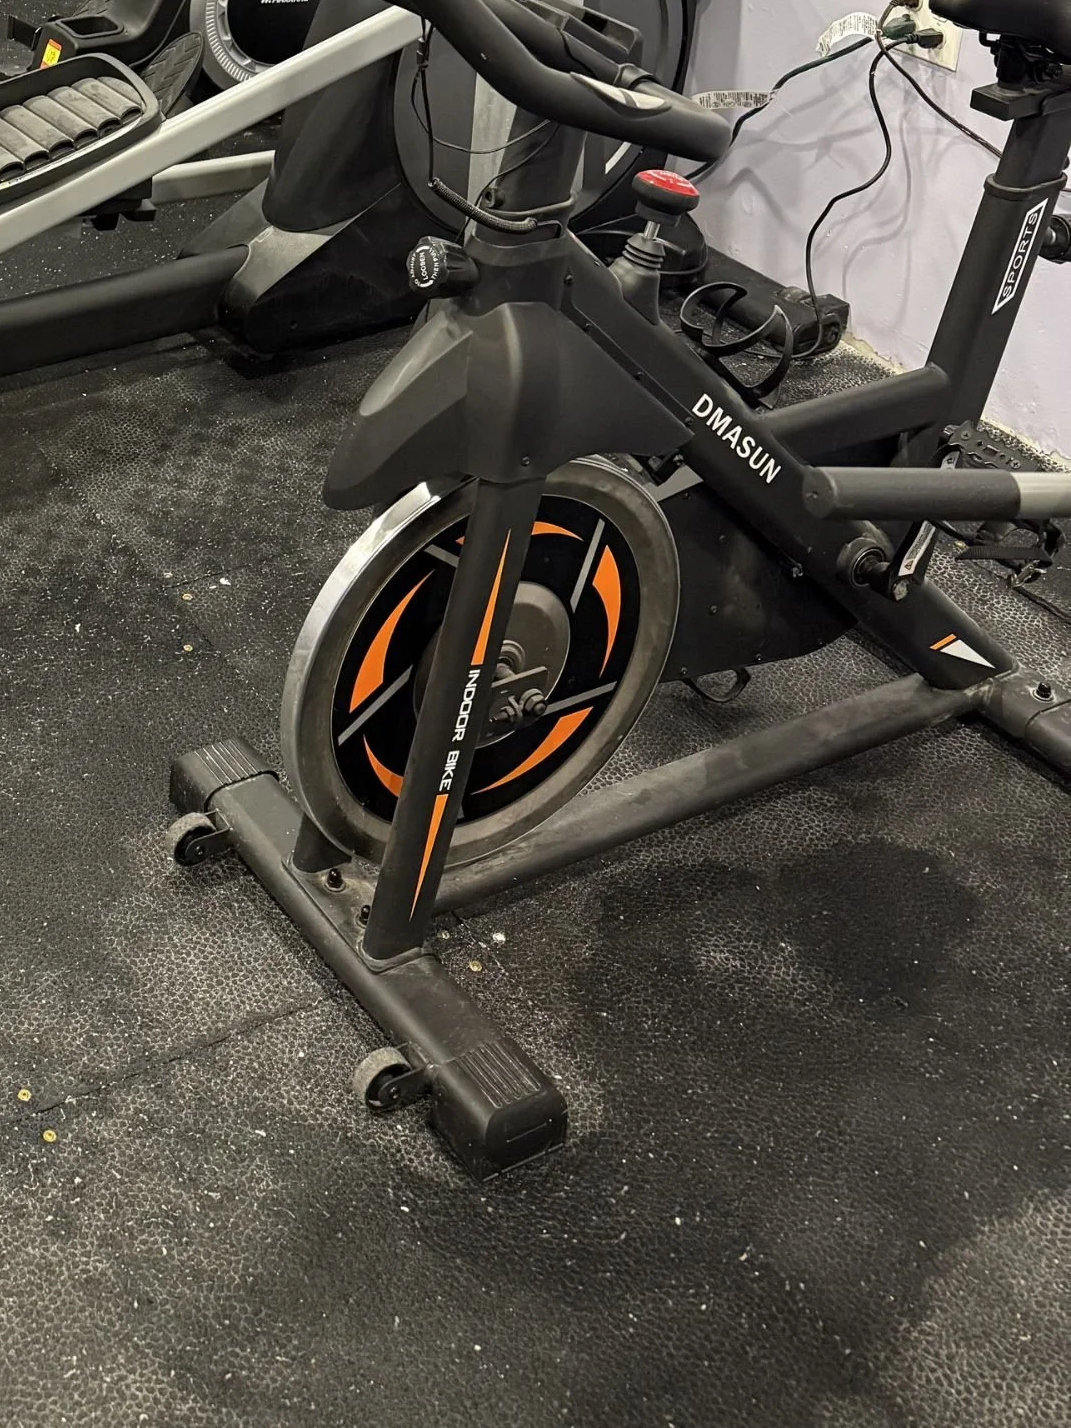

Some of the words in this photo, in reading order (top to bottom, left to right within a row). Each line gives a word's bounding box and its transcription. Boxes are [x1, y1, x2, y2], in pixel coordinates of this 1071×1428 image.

[1002, 212, 1038, 298] SPORTS
[693, 394, 781, 483] DMASUN
[451, 669, 481, 742] INDOOR
[440, 751, 459, 791] BIKE
